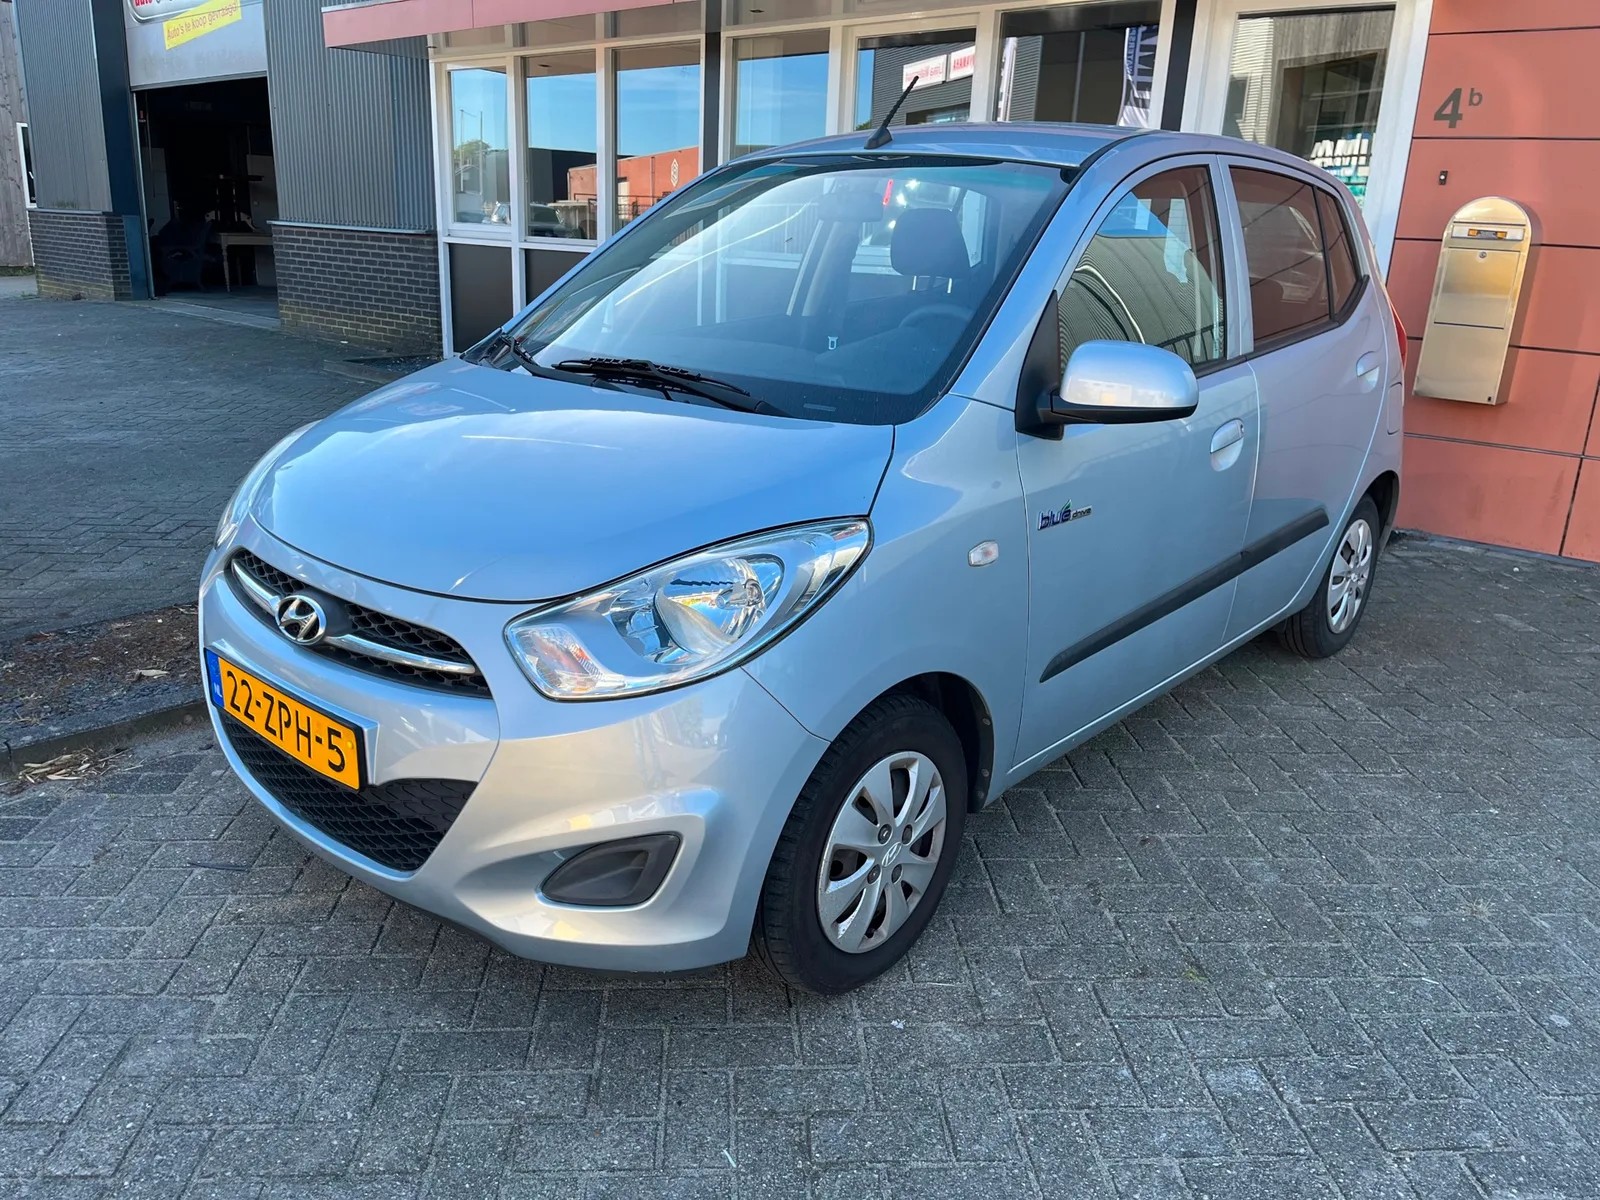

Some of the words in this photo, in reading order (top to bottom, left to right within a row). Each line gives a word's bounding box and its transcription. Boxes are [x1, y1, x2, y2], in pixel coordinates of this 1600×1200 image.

[167, 23, 185, 40] Auto's
[185, 21, 192, 33] te
[192, 15, 208, 30] koop
[1037, 505, 1071, 531] blue
[1072, 507, 1092, 520] drive
[213, 682, 223, 698] NL
[226, 670, 346, 773] 22-ZPH-5
